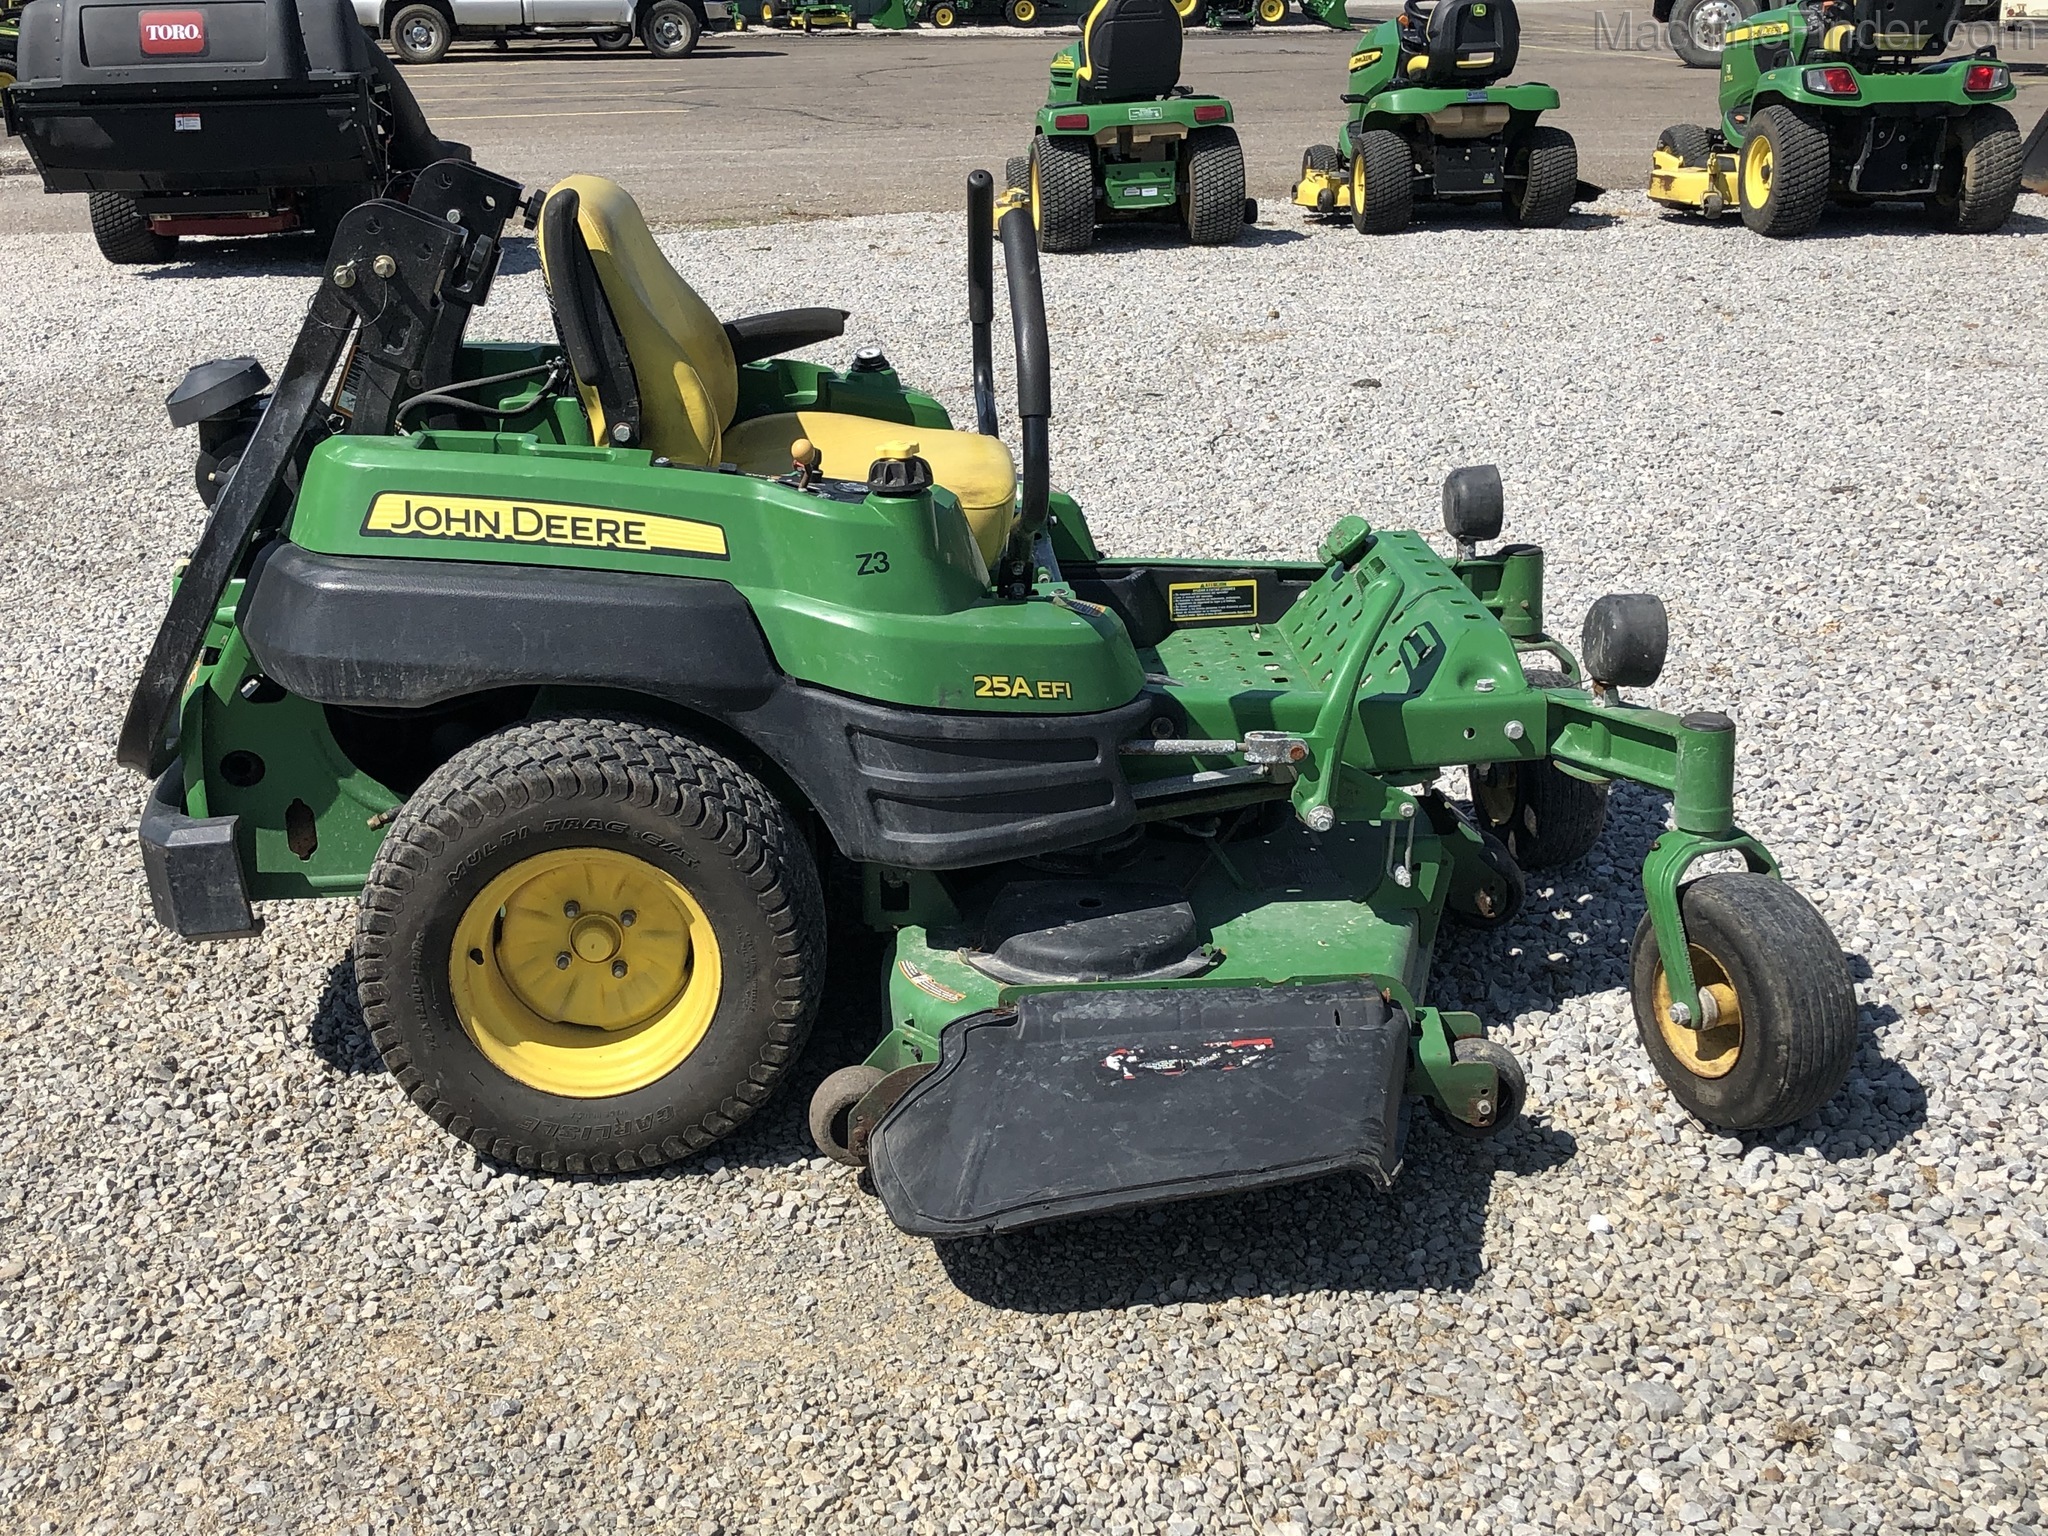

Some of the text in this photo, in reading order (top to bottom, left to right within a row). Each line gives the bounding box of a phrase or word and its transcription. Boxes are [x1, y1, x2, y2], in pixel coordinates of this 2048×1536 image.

[145, 24, 200, 41] TORO
[391, 499, 647, 546] JOHN DEERE
[855, 550, 891, 576] Z3
[973, 675, 1072, 700] 25A EFI
[446, 825, 529, 887] MULTI
[543, 817, 631, 834] TRAC
[515, 1104, 676, 1142] CARLISLE
